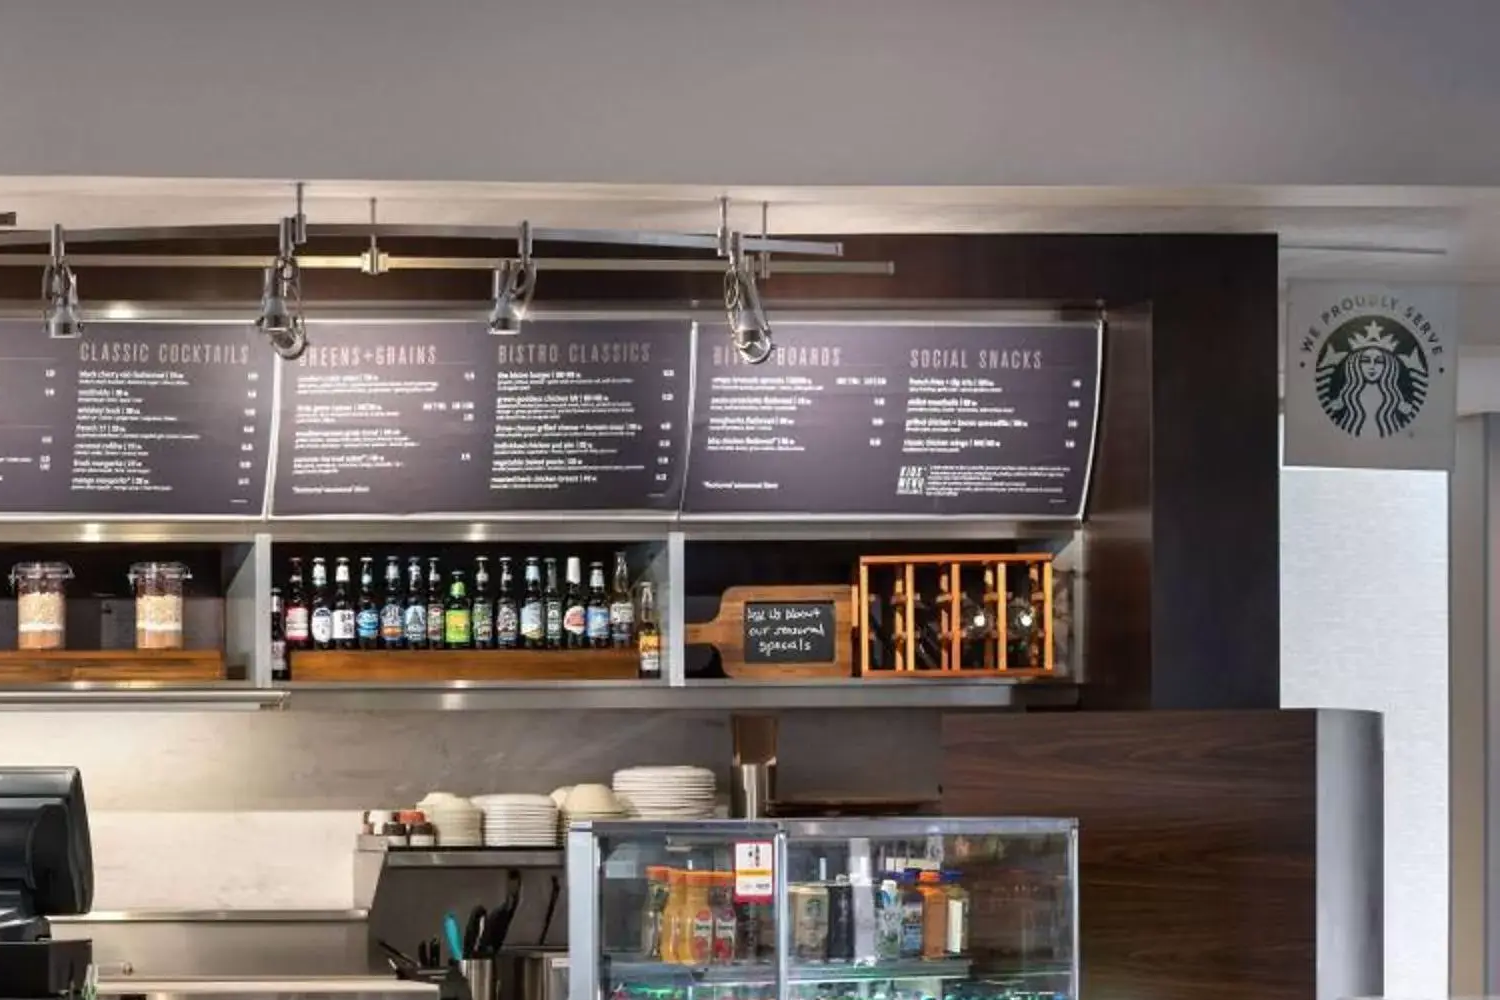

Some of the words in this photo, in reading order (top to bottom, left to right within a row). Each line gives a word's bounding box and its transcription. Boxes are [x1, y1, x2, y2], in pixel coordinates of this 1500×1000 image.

[1301, 325, 1320, 353] WE
[1321, 295, 1400, 325] PROUDLY
[1404, 306, 1443, 355] SERVE
[79, 342, 150, 363] CLASSIC
[158, 343, 250, 365] COCKTAILS
[498, 344, 559, 364] BISTRO
[568, 342, 652, 363] CLASSICS
[909, 348, 969, 369] SOCIAL
[979, 350, 1043, 370] SNACKS
